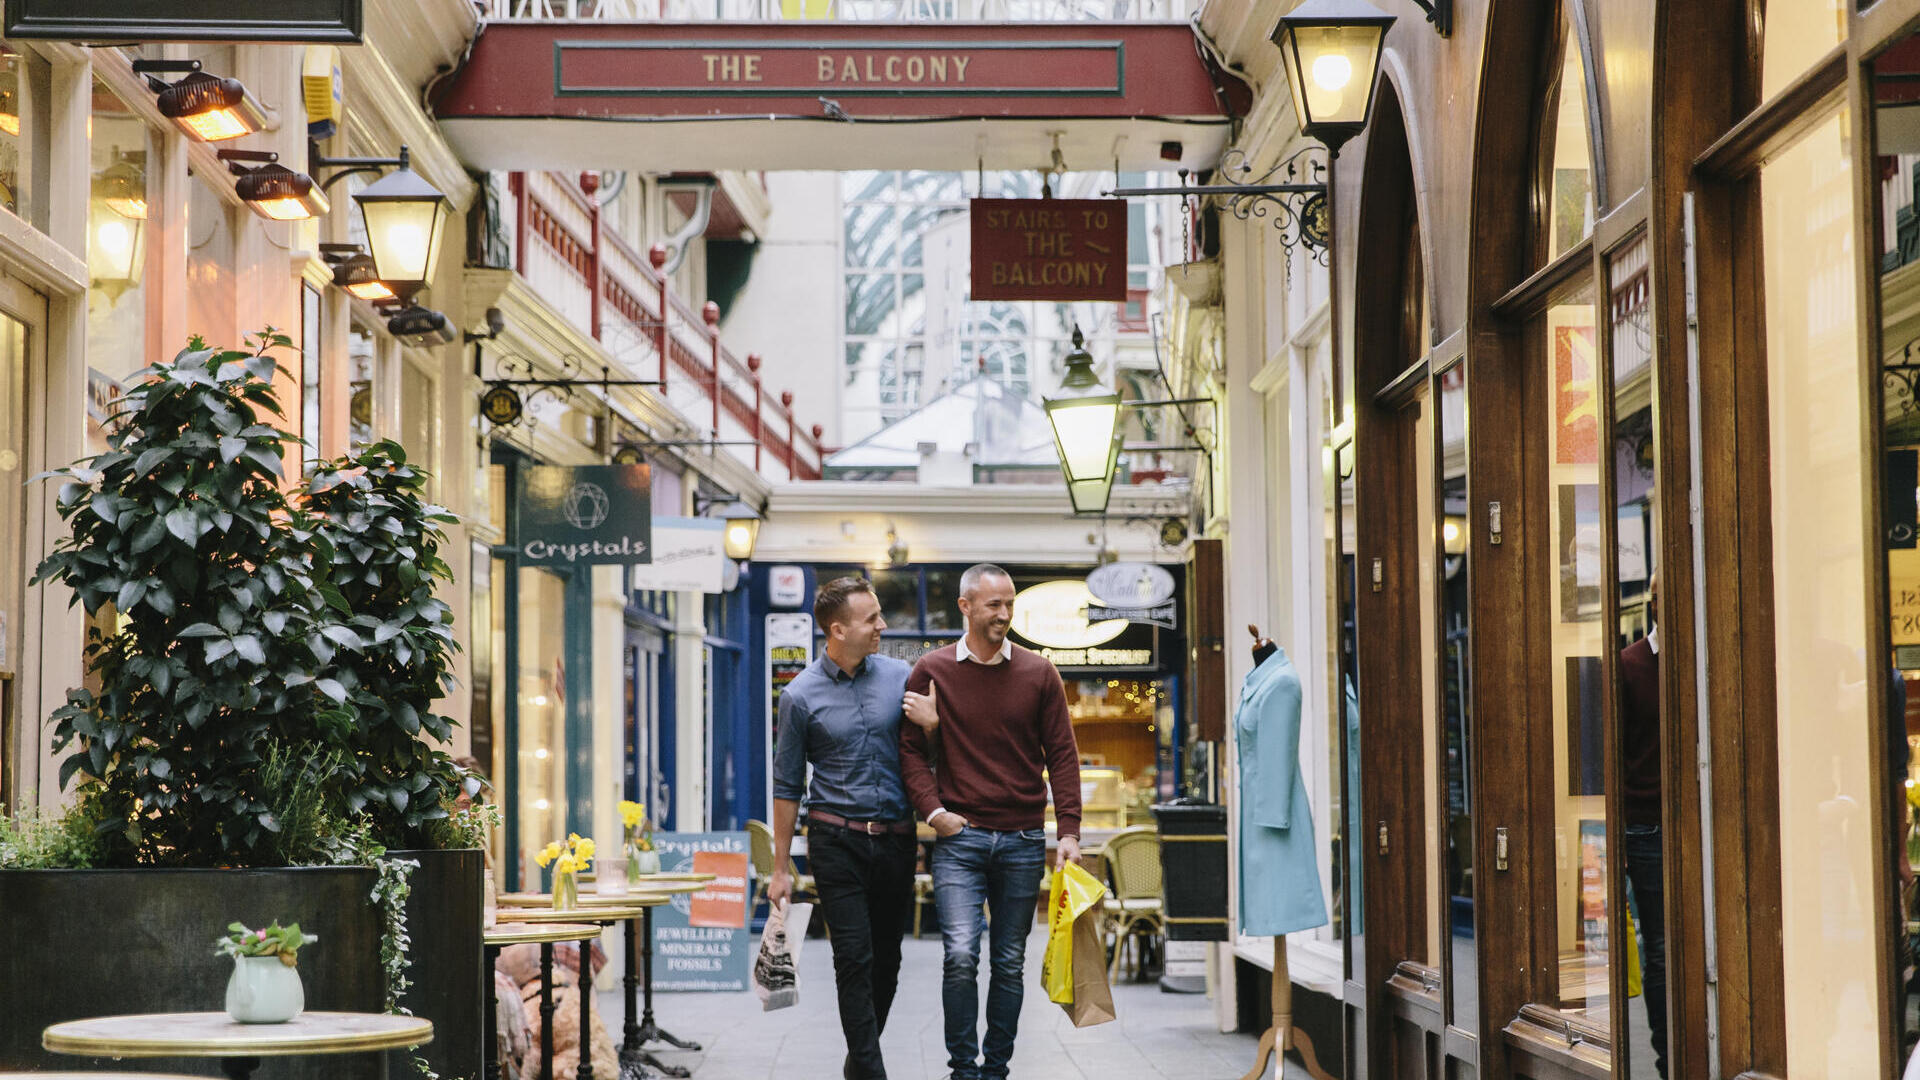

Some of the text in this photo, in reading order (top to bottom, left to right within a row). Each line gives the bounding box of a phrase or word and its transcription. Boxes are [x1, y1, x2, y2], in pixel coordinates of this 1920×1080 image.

[702, 55, 970, 83] THE BALCONY
[986, 210, 1109, 230] STAIRS TO
[1024, 232, 1074, 257] THE
[991, 261, 1109, 287] BALCONY
[524, 536, 648, 562] Crystals
[653, 837, 744, 857] Crystals
[656, 927, 734, 941] JEWELLERY
[660, 942, 731, 957] MINERALS
[667, 958, 723, 971] FOSSILS
